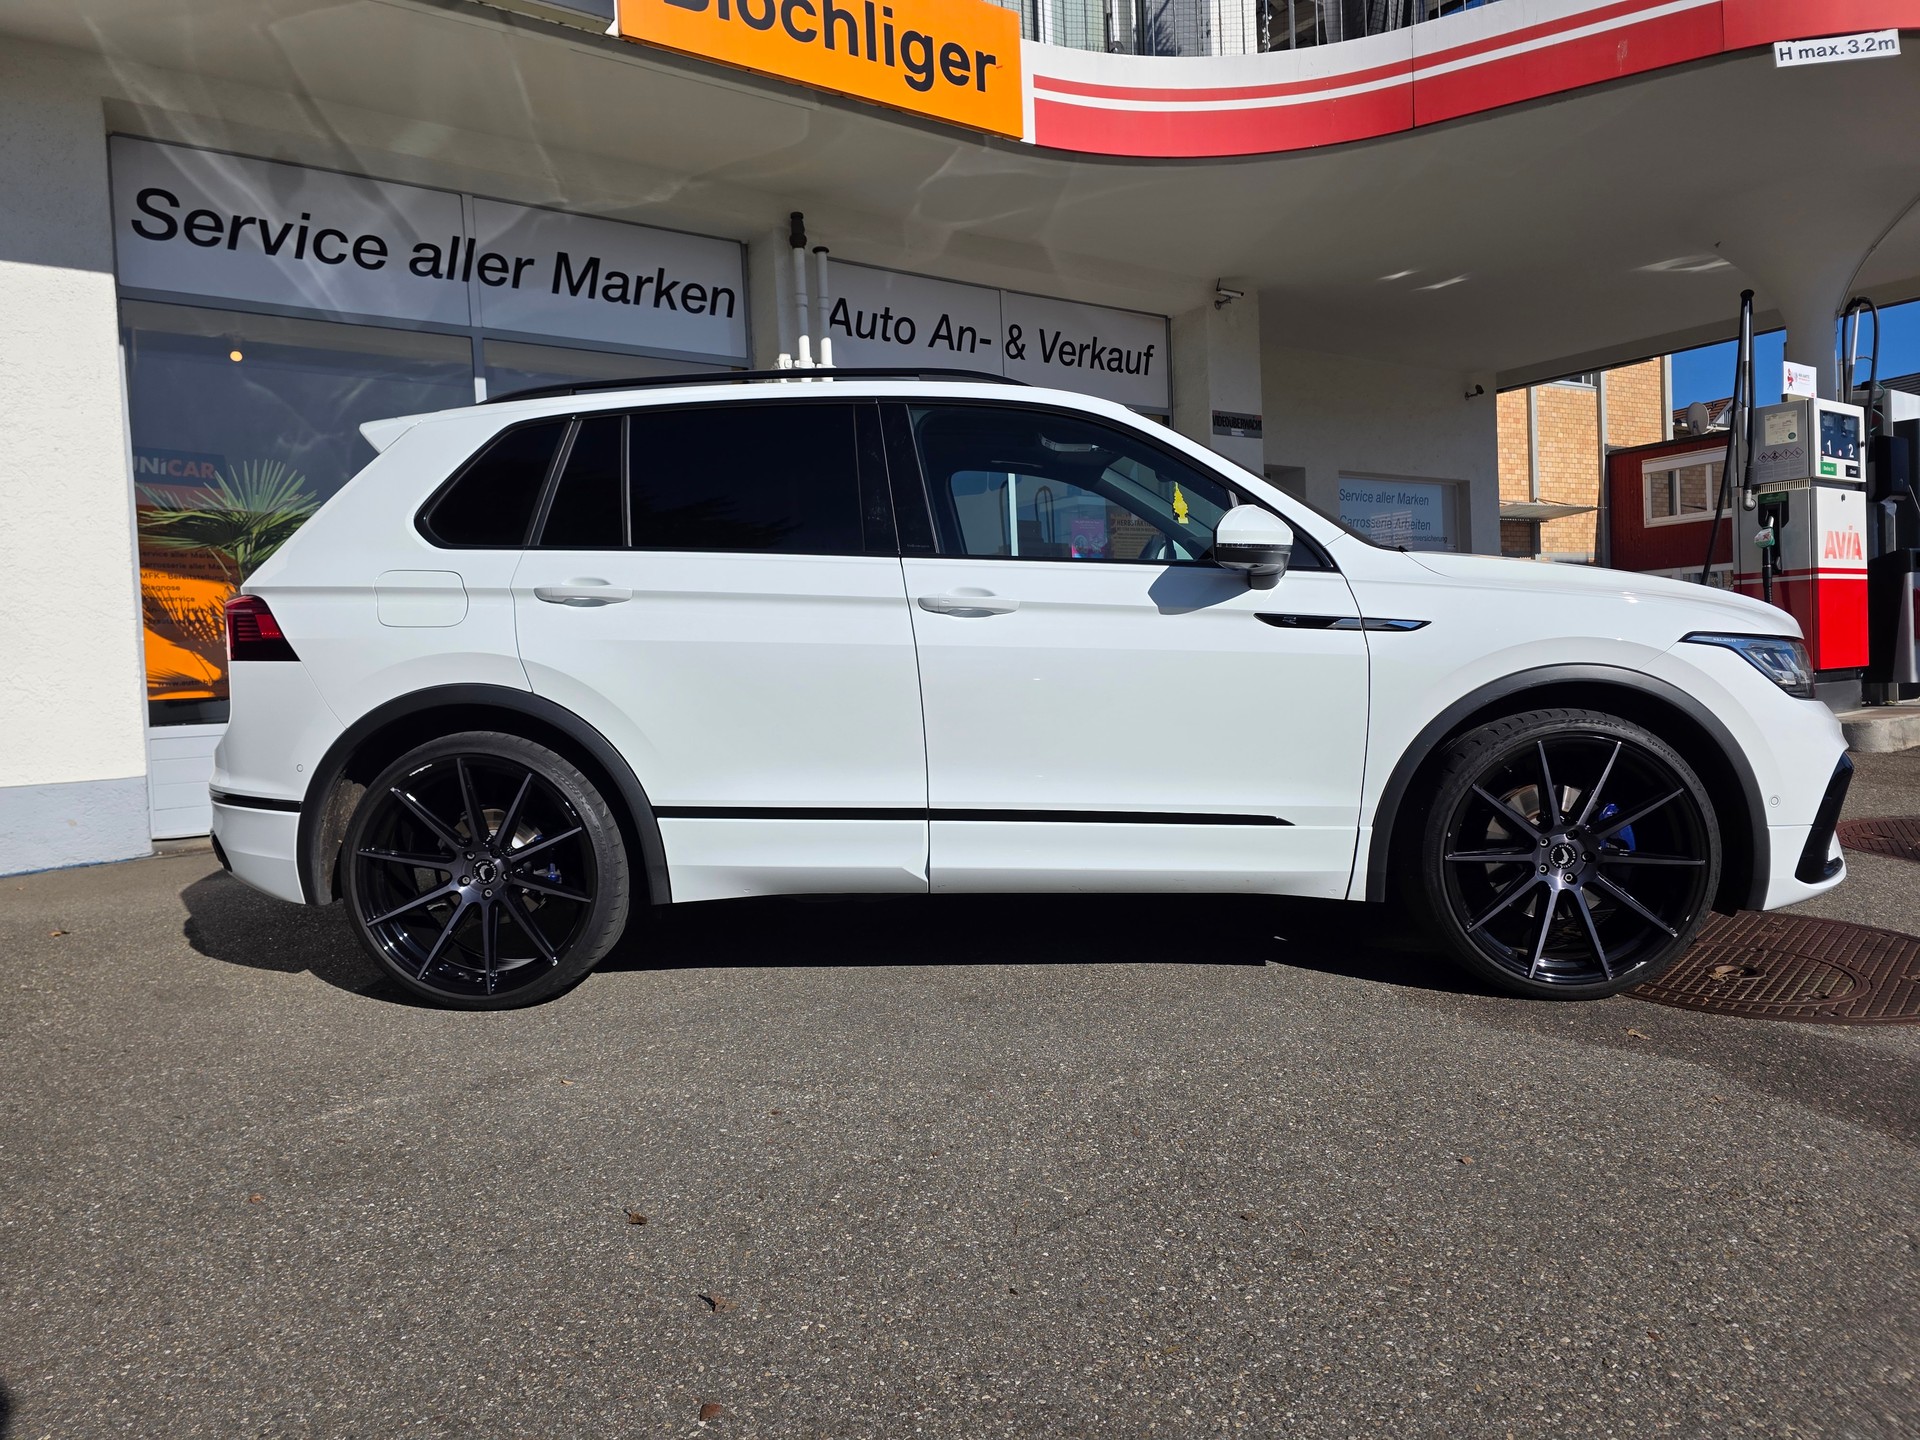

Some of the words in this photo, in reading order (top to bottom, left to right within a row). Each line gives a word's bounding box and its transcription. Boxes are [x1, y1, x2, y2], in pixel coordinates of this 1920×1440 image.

[1779, 46, 1792, 61] H
[1798, 44, 1844, 60] max.
[1847, 37, 1895, 54] 3.2m
[131, 187, 389, 270] Service
[409, 235, 535, 289] aller
[552, 251, 735, 318] Marken
[829, 297, 916, 345] Auto
[928, 313, 991, 354] An-
[1004, 324, 1026, 361] &
[1038, 329, 1155, 376] Verkauf
[1826, 440, 1832, 455] 1
[1848, 444, 1855, 458] 2
[1339, 488, 1373, 504] Service
[1375, 491, 1395, 505] aller
[1397, 492, 1429, 506] Marken
